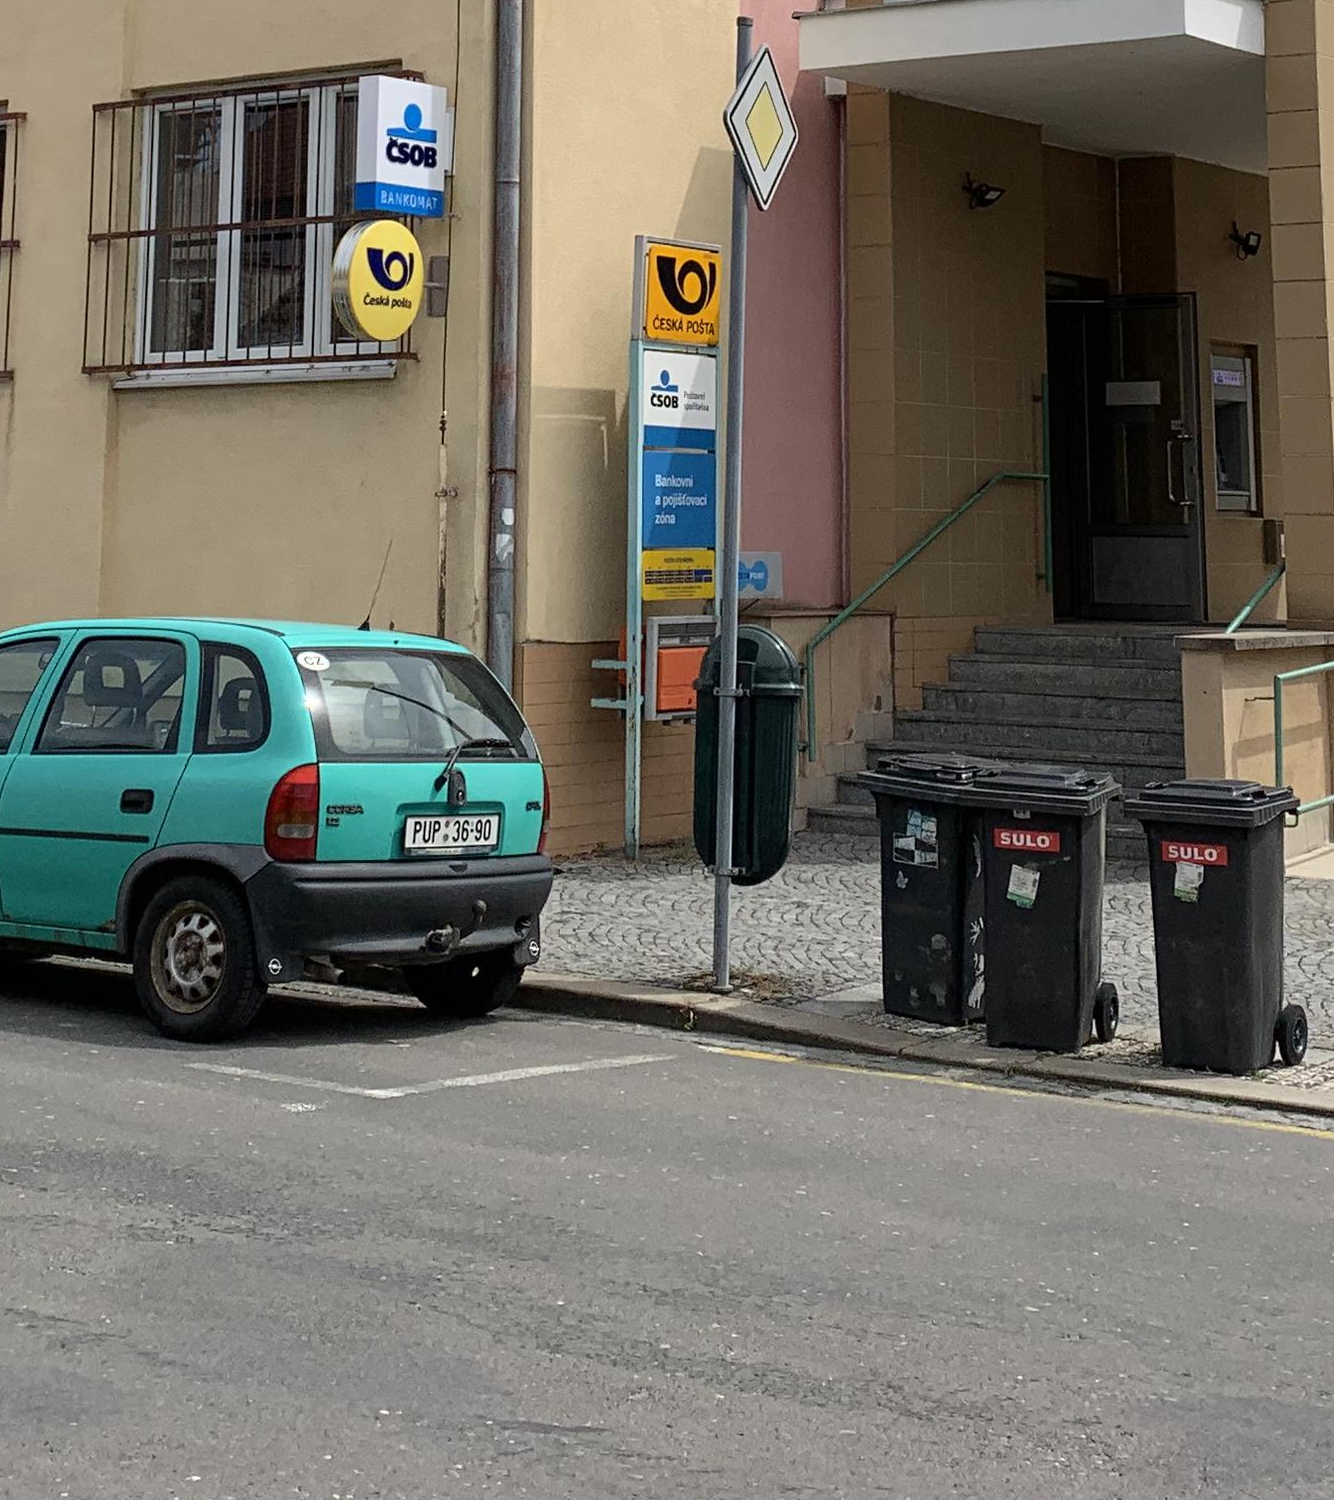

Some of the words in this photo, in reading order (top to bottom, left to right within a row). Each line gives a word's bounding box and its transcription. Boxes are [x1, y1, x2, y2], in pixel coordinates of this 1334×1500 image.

[385, 136, 437, 169] ČSOB
[380, 189, 437, 211] BANKOMAT
[363, 292, 390, 306] Česká
[652, 316, 684, 332] ČESKÁ
[686, 319, 715, 336] POŠTA
[650, 392, 679, 409] ČSOB
[654, 474, 694, 488] Bankovní
[654, 495, 662, 506] a
[654, 511, 676, 525] zóna
[303, 656, 326, 666] CZ
[412, 820, 442, 845] PUP
[451, 818, 492, 843] 36-90
[1000, 831, 1051, 849] SULO
[1167, 844, 1218, 863] SULO
